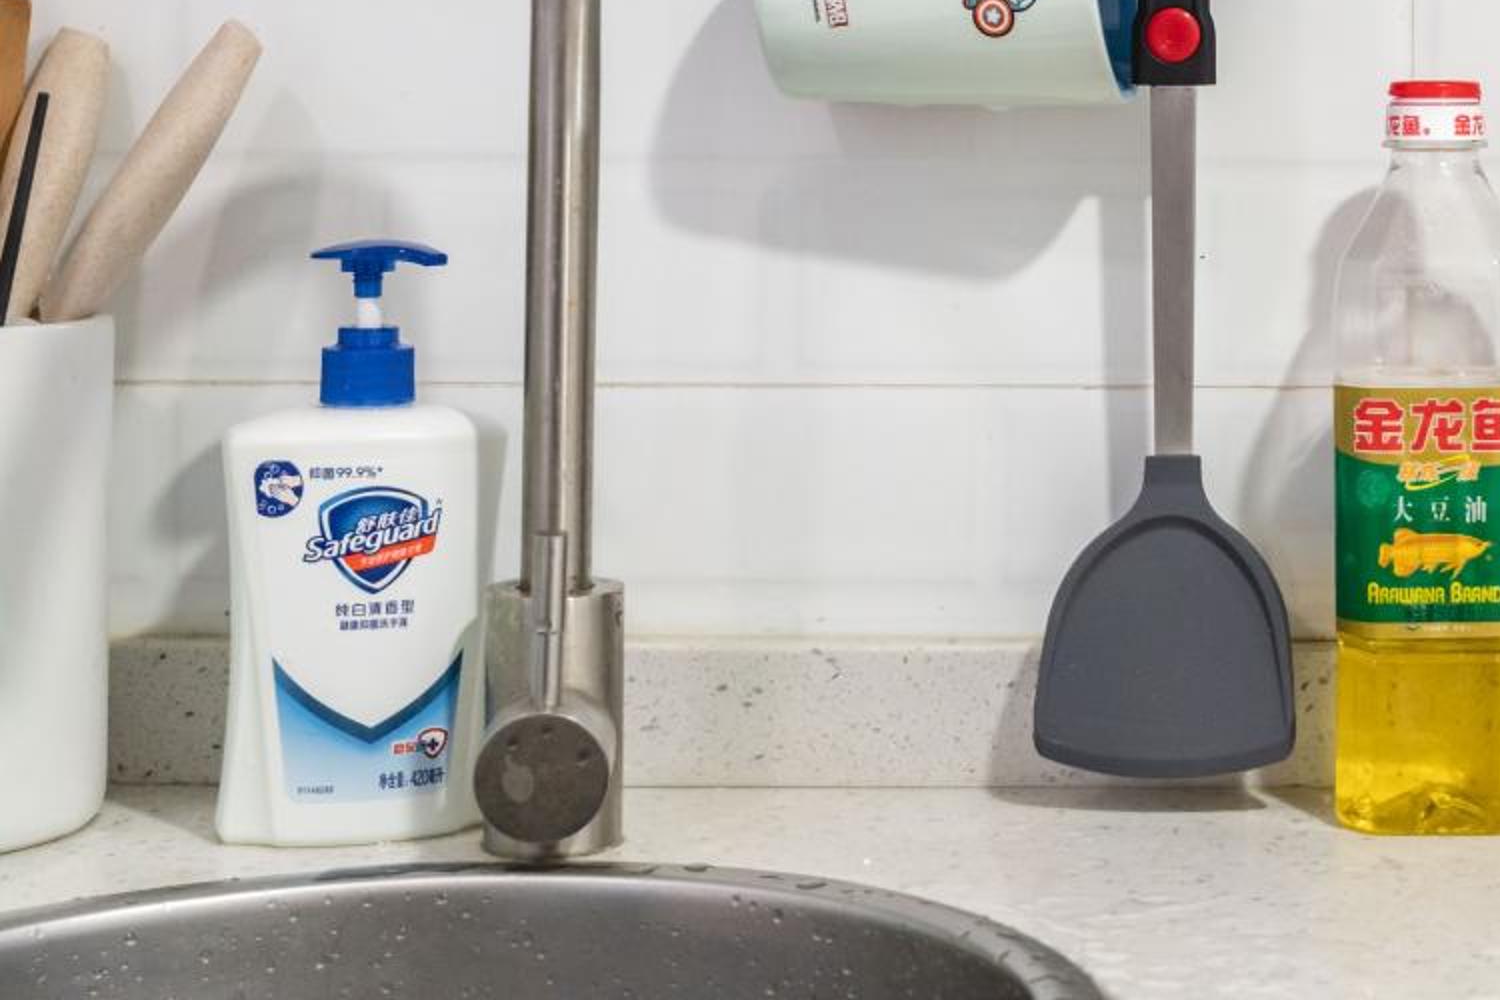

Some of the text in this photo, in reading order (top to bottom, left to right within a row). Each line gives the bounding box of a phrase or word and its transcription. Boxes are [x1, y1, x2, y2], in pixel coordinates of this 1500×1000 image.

[1394, 496, 1487, 523] 大豆油
[303, 507, 443, 564] Safeguard
